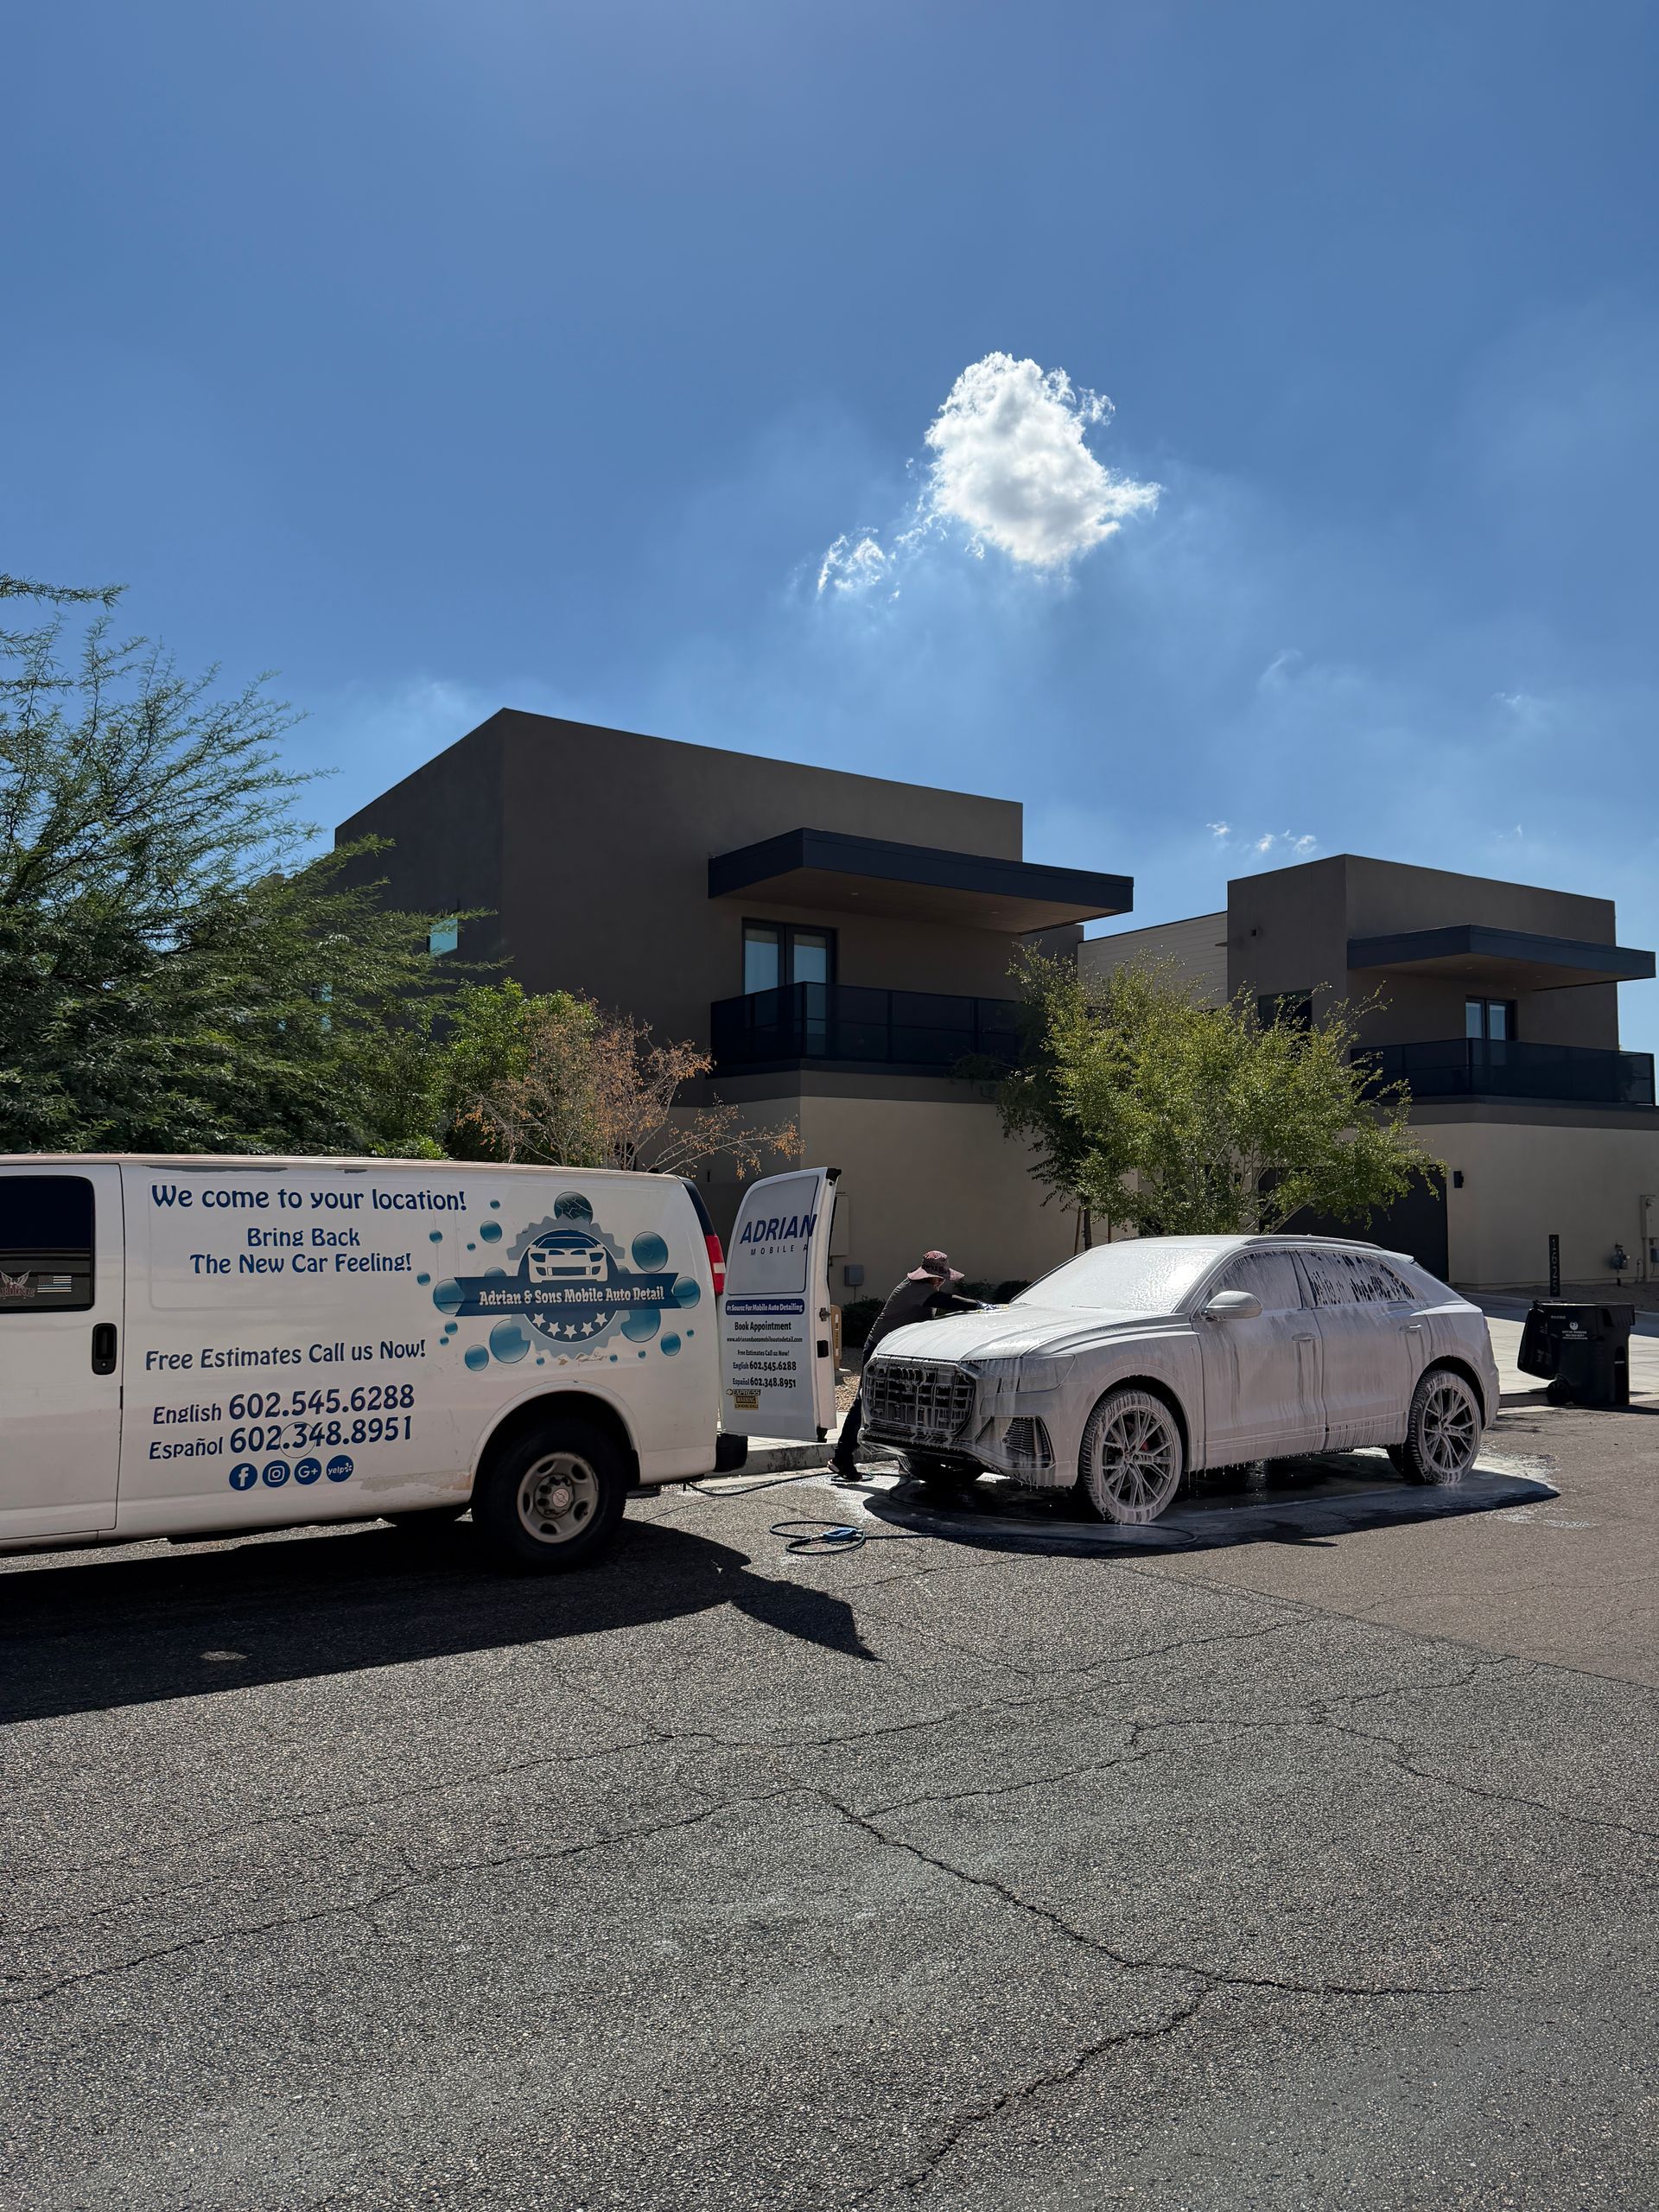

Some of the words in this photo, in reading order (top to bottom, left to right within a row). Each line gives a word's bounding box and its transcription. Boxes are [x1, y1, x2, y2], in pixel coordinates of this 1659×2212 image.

[151, 1185, 193, 1208] We
[202, 1191, 270, 1208] come
[277, 1188, 302, 1208] to
[310, 1192, 365, 1209] your
[372, 1189, 467, 1211] location!
[247, 1228, 303, 1247] Bring
[312, 1228, 361, 1247] Back
[740, 1214, 817, 1244] ADRIAN
[751, 1245, 794, 1255] MOBILE
[190, 1254, 232, 1274] The
[239, 1254, 284, 1274] New
[292, 1254, 328, 1273] Car
[335, 1253, 413, 1272] Feeling!
[480, 1290, 522, 1306] Adrian
[524, 1290, 532, 1304] &
[534, 1289, 563, 1304] Sons
[563, 1287, 603, 1302] Mobile
[605, 1287, 631, 1301] Auto
[632, 1286, 664, 1300] Detail
[779, 1303, 803, 1312] Detailing
[734, 1321, 749, 1331] Book
[750, 1320, 791, 1332] Appointment
[146, 1351, 193, 1370] Free
[200, 1347, 302, 1368] Estimates
[308, 1342, 345, 1363] Call
[352, 1345, 373, 1361] us
[380, 1339, 426, 1359] Now!
[733, 1362, 749, 1370] English
[749, 1361, 797, 1371] 602.545.6288
[750, 1376, 796, 1389] 602.348.8951
[153, 1403, 221, 1425] English
[229, 1384, 415, 1421] 602.545.6288
[149, 1437, 223, 1459] Español
[230, 1415, 412, 1453] 602.348.8951
[328, 1465, 345, 1476] yelp
